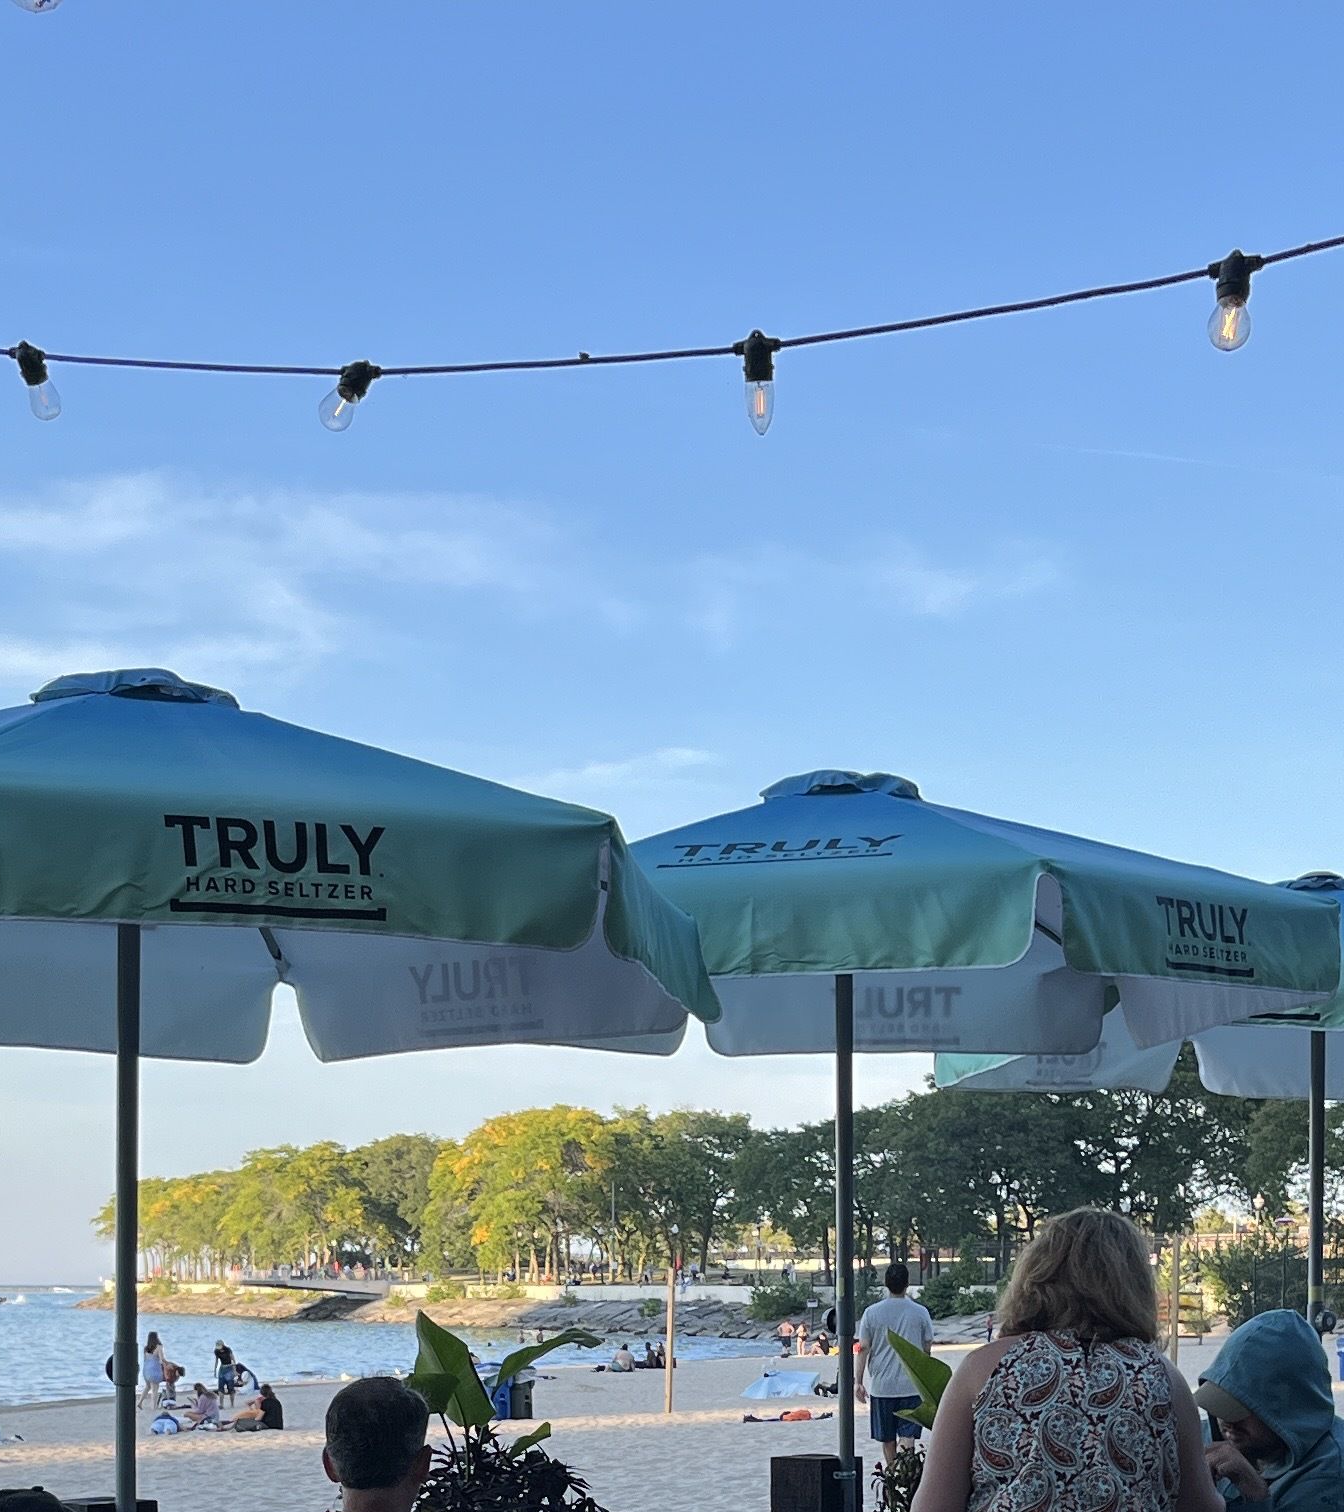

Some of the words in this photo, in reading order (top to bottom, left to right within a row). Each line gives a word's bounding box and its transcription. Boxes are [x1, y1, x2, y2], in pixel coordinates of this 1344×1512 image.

[163, 814, 386, 876] TRULY
[674, 834, 904, 857] TRULY
[186, 876, 256, 895] HARD
[268, 880, 373, 901] SELTZER
[1156, 895, 1248, 946] TRULY
[1168, 943, 1199, 957] HARD
[1203, 946, 1248, 963] SELTZER
